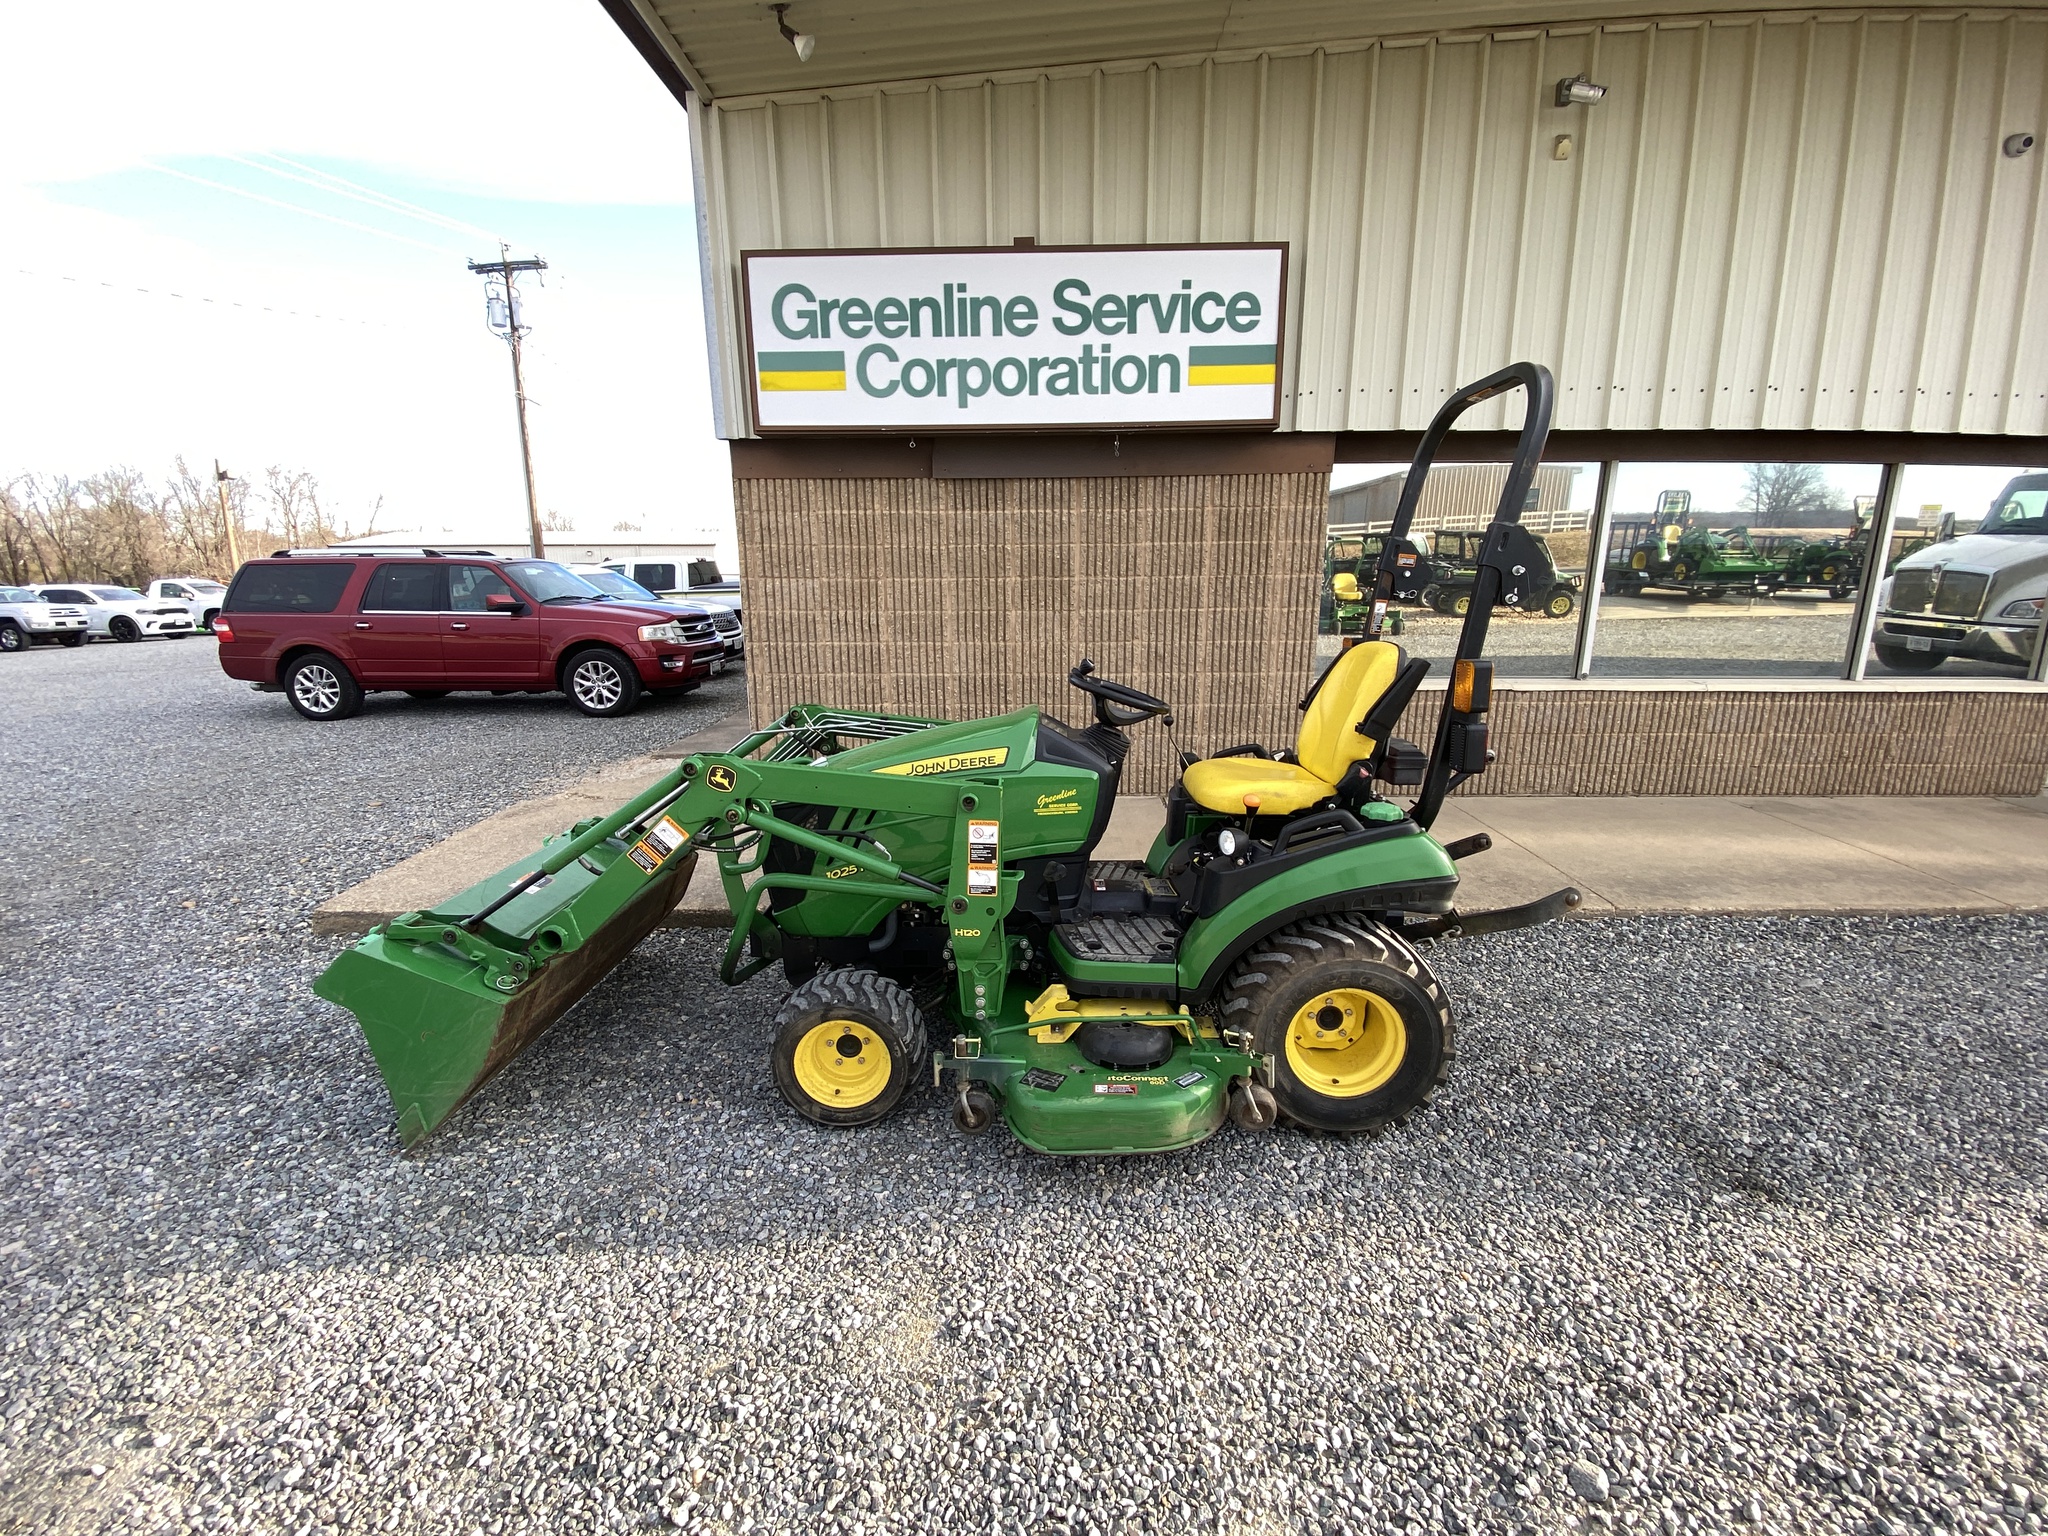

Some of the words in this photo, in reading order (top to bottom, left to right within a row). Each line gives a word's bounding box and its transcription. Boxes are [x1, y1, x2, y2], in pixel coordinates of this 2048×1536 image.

[771, 283, 1038, 339] Greenline
[1052, 279, 1261, 336] Service
[856, 343, 1181, 409] Corporation
[906, 761, 946, 775] JOHN
[949, 756, 996, 769] DEERE
[1037, 789, 1077, 809] Greenline
[826, 865, 864, 879] 1025
[954, 928, 981, 937] H120
